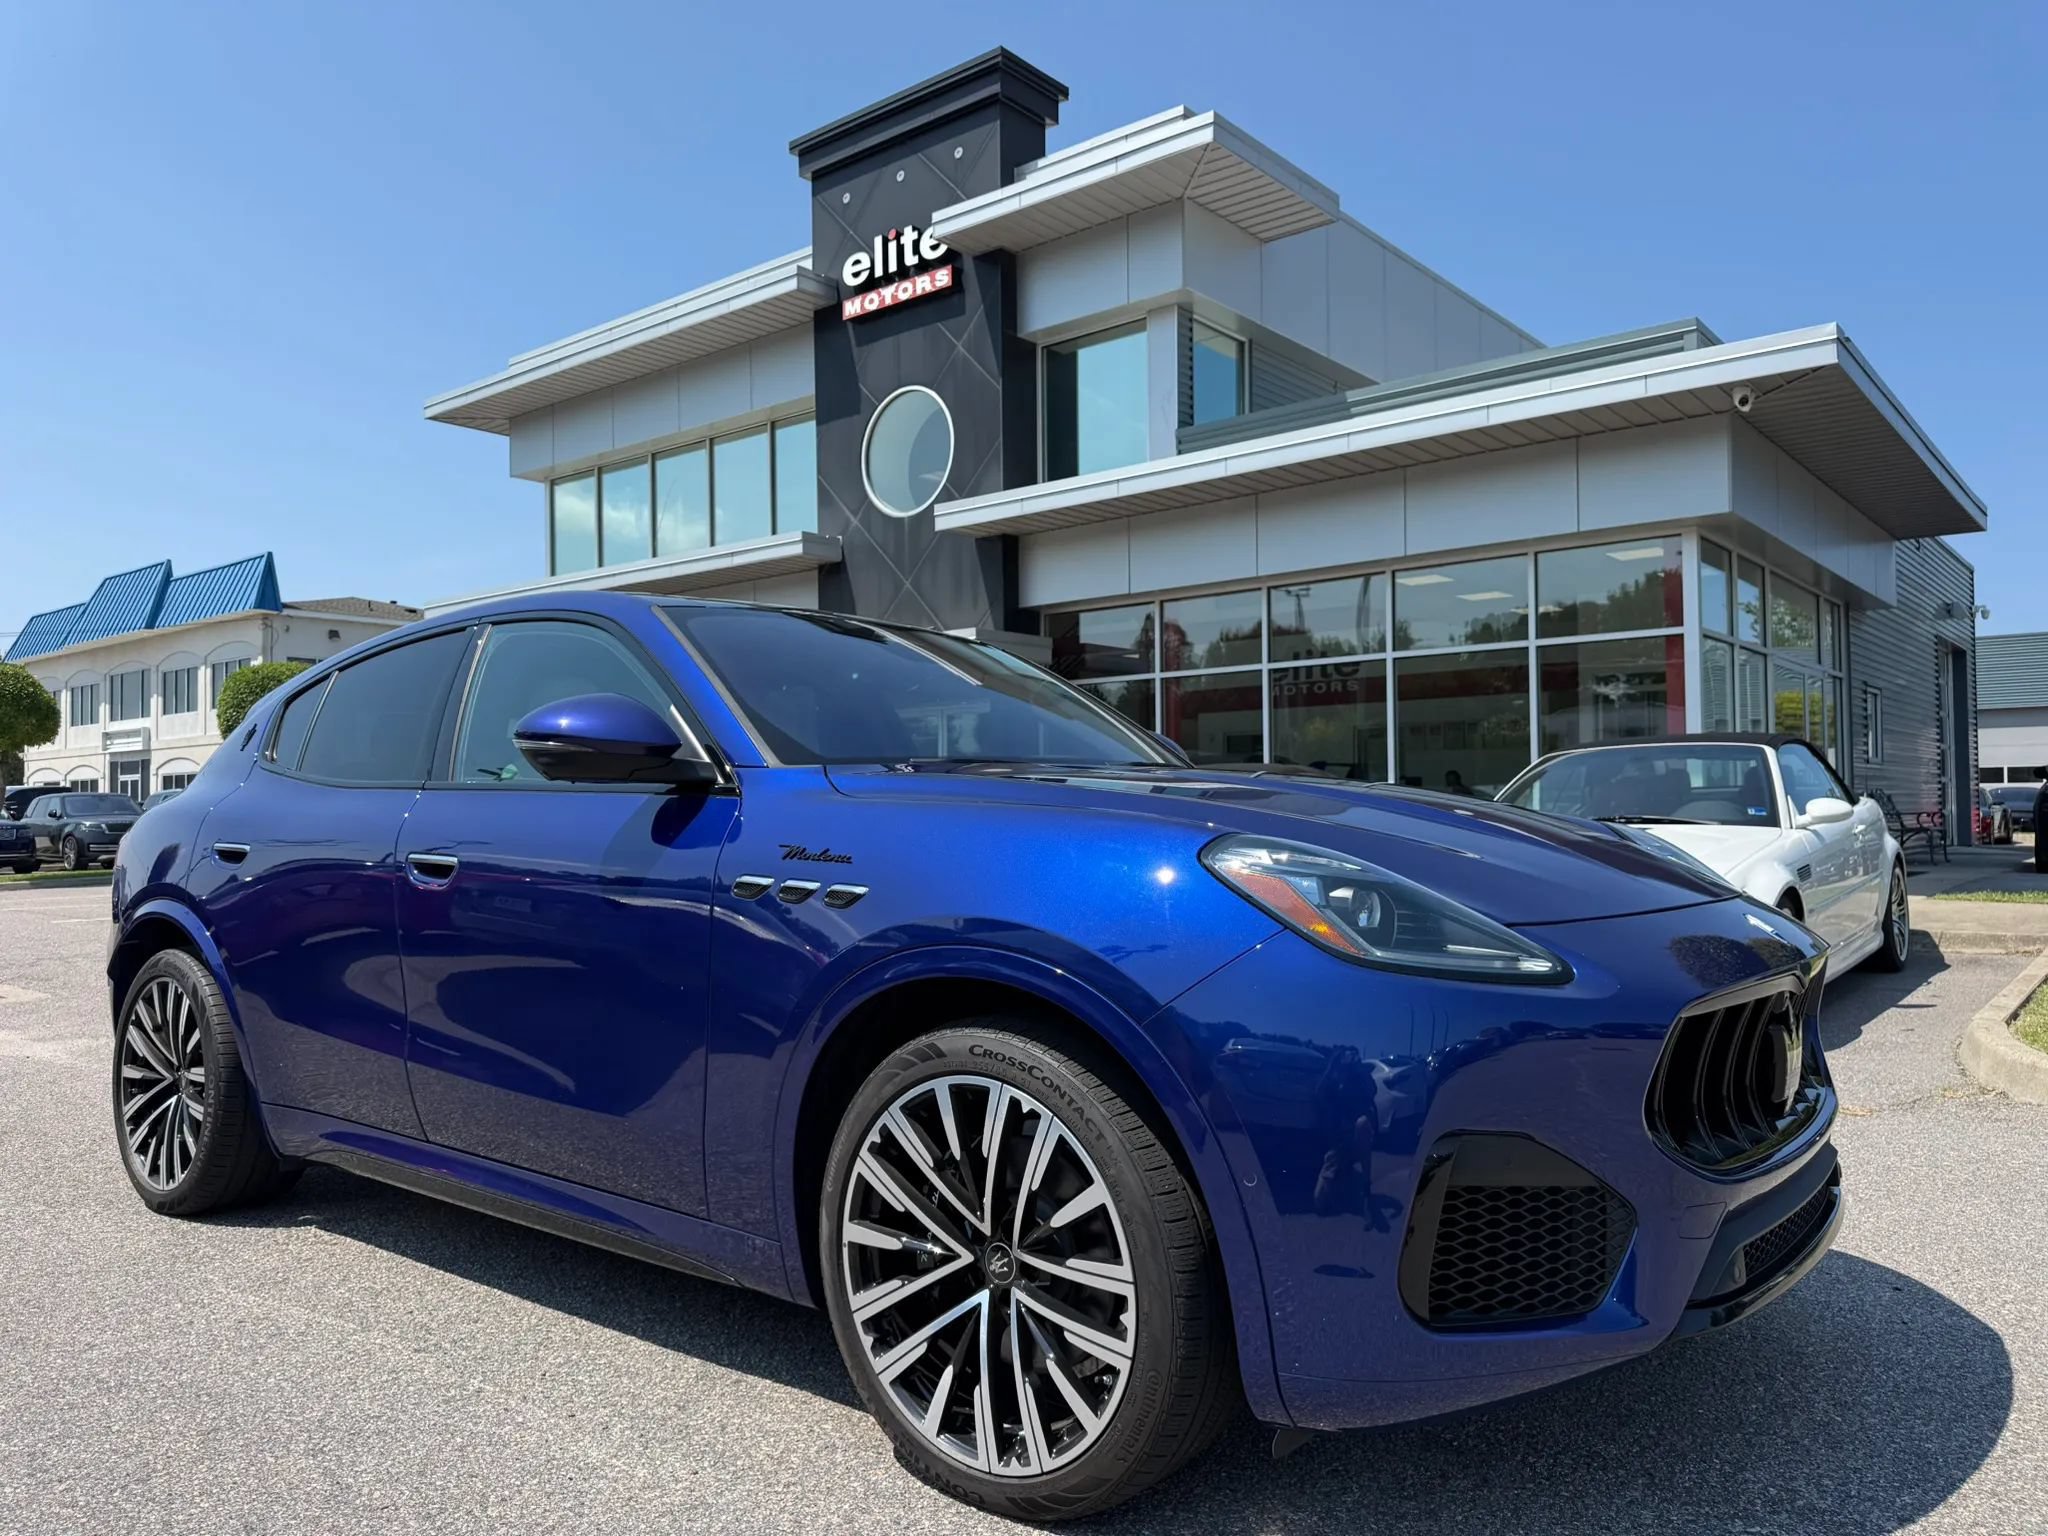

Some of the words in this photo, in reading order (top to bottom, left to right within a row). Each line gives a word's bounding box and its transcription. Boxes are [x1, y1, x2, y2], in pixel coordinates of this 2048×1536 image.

[842, 224, 948, 287] elite
[845, 269, 949, 317] MOTORS
[1123, 1368, 1164, 1455] Continental
